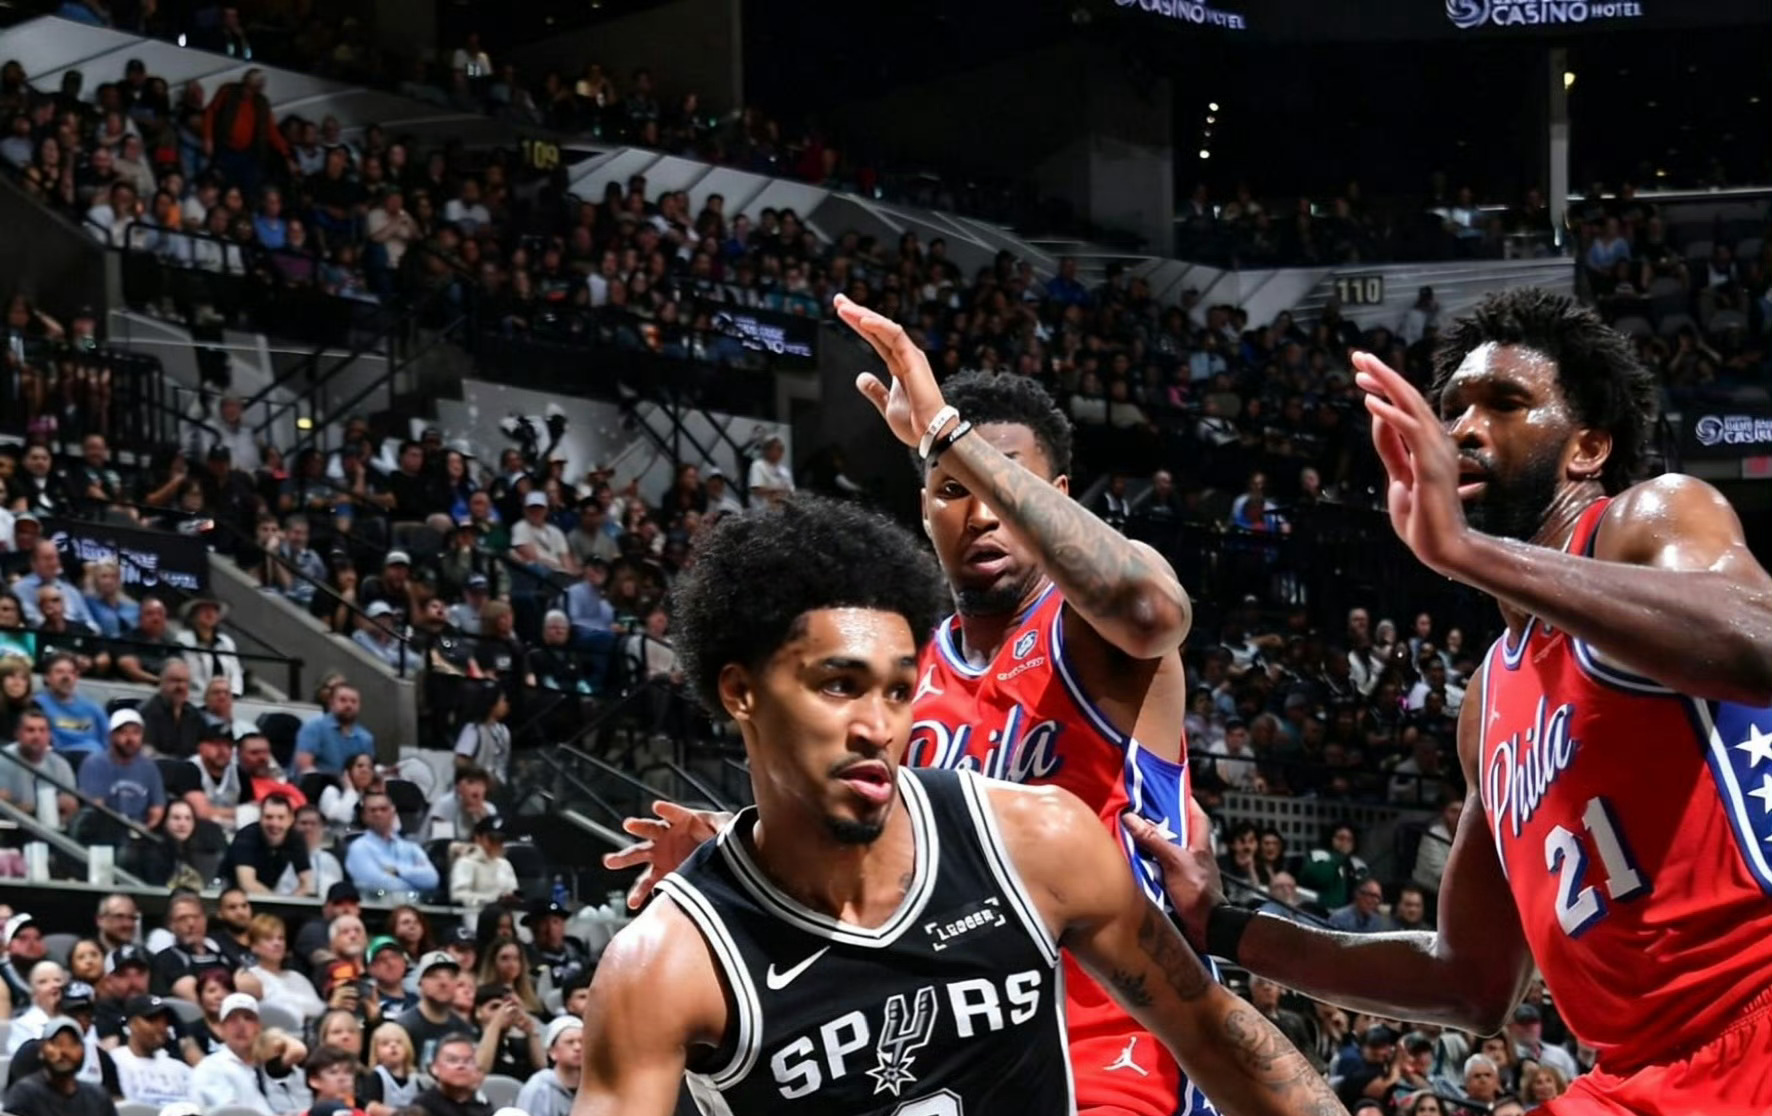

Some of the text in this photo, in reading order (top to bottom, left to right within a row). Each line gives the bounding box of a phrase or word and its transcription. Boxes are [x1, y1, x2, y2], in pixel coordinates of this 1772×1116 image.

[1491, 2, 1643, 26] CASINO HOTEL
[1337, 278, 1381, 303] 110
[1488, 695, 1577, 880] Phila
[1545, 796, 1651, 938] 21
[770, 969, 1043, 1099] SPURS
